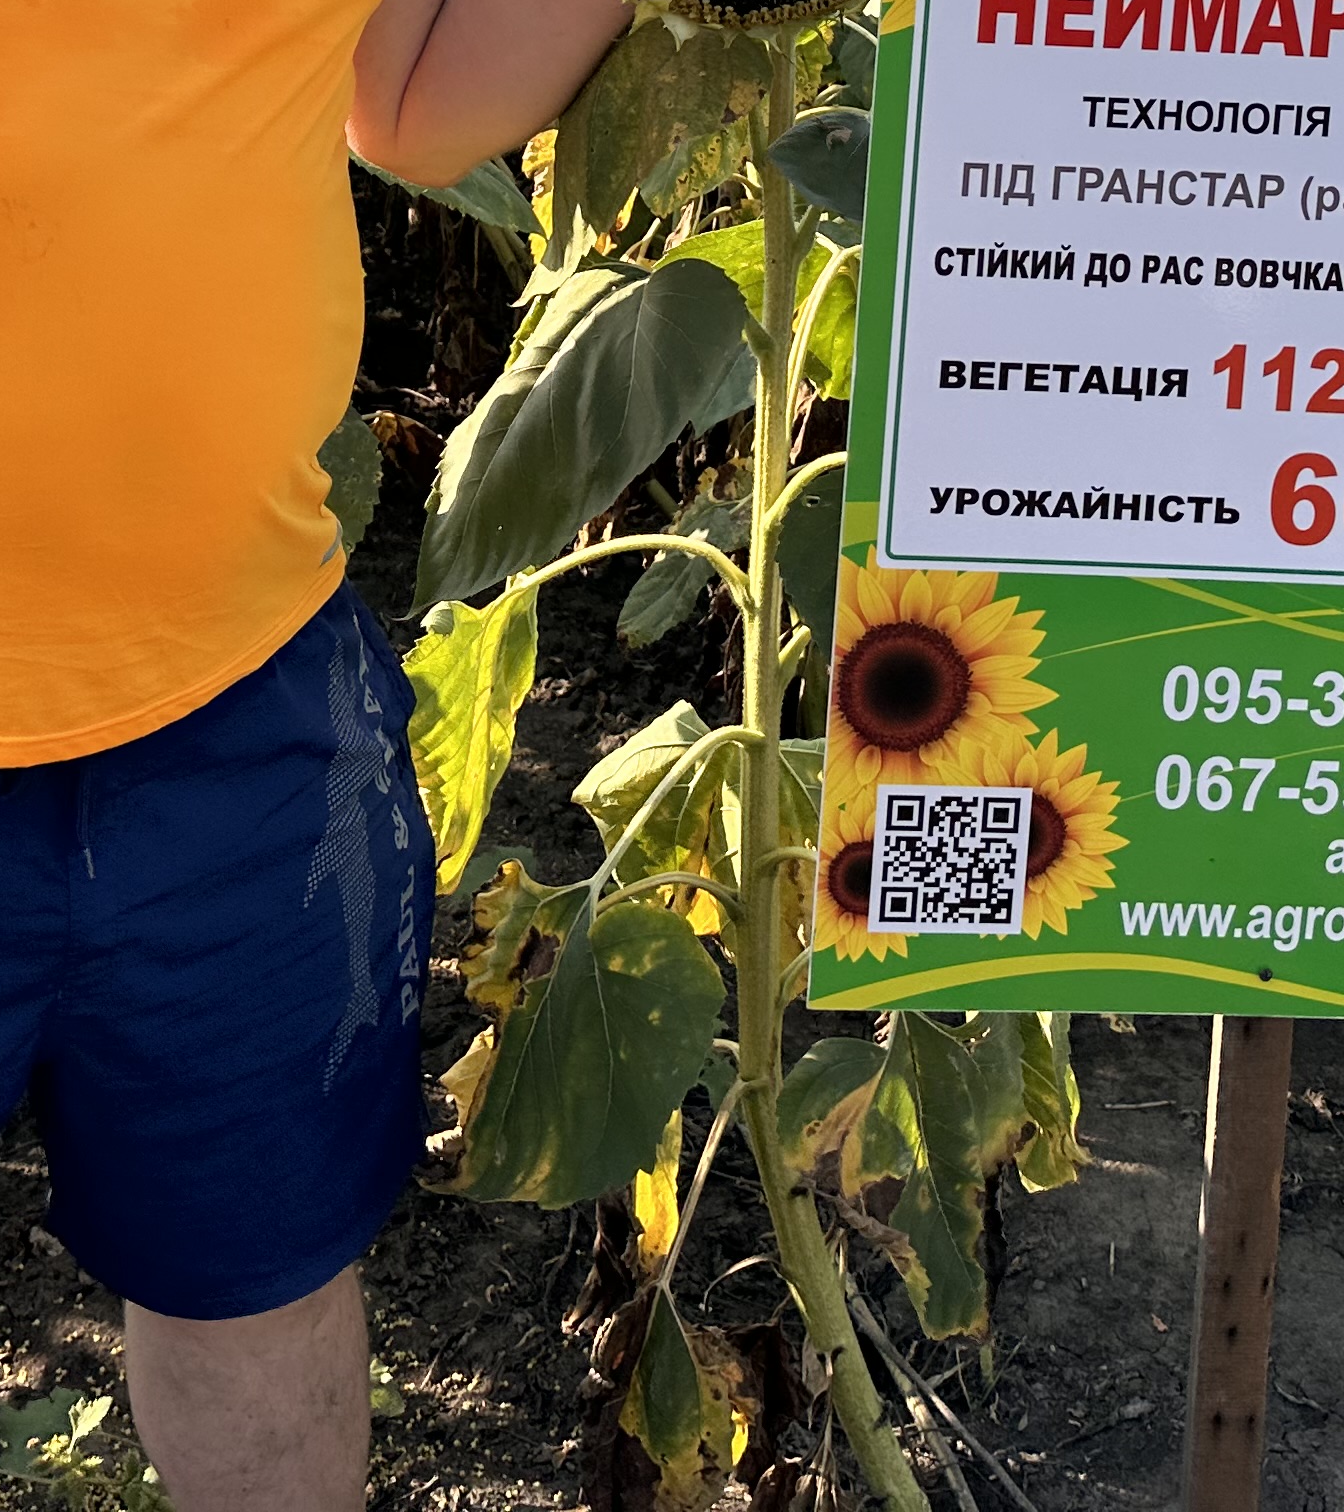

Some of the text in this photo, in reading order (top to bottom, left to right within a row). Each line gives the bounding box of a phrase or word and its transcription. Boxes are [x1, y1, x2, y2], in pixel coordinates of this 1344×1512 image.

[1083, 96, 1331, 137] ТЕХНОЛОГІЯ
[962, 163, 1034, 206] ПІД
[1052, 166, 1284, 208] ГРАНСТАР
[935, 242, 1075, 280] СТІЙКИЙ
[1084, 253, 1131, 287] ДО
[1142, 255, 1204, 285] РАС
[939, 360, 1188, 401] ВЕГЕТАЦІЯ
[930, 486, 1239, 524] УРОЖАЙНІСТЬ
[392, 802, 409, 850] &
[397, 864, 420, 1026] PAUL
